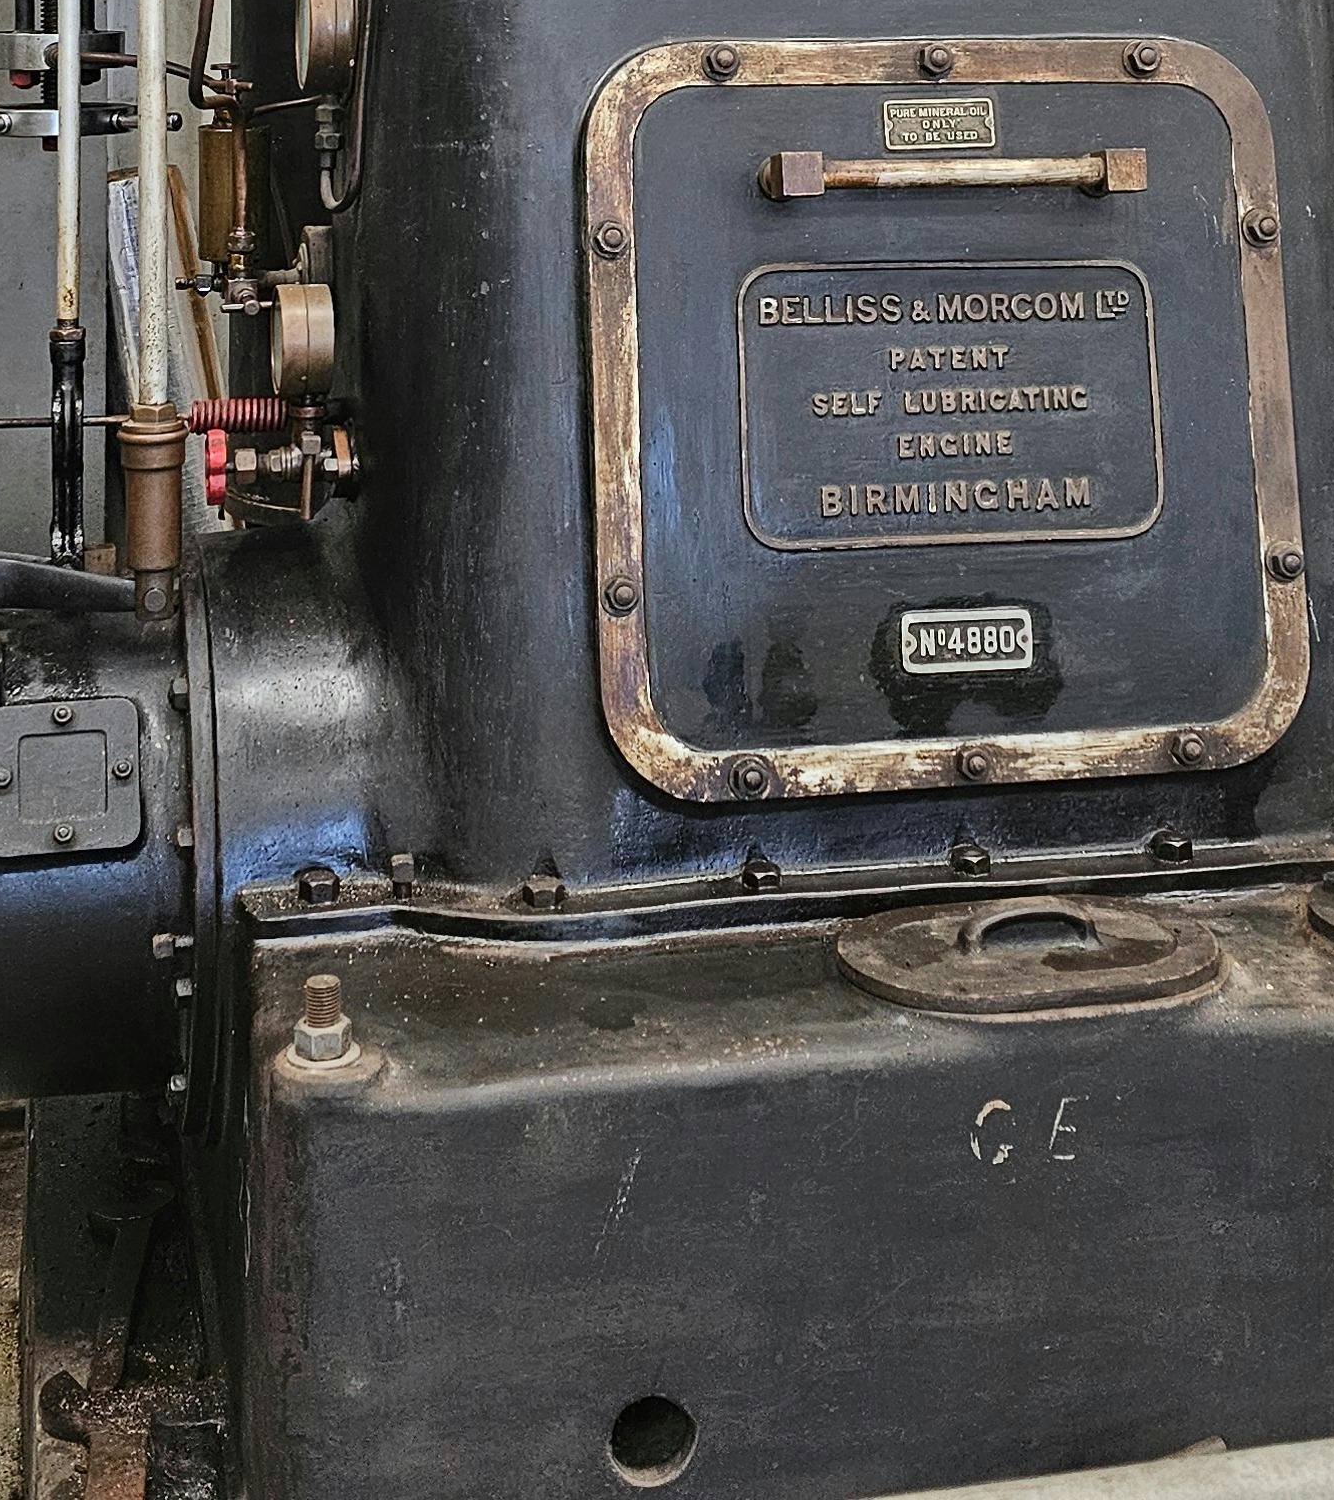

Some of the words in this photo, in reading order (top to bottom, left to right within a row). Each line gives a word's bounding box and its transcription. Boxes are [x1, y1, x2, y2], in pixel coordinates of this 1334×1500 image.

[889, 107, 916, 118] PURE
[918, 107, 967, 117] MINERAL
[969, 106, 987, 116] OIL
[922, 119, 956, 129] ONLY
[901, 132, 918, 142] TO
[925, 131, 940, 141] BE
[947, 130, 978, 140] USED
[759, 294, 902, 325] BELLISS
[912, 300, 930, 323] &
[938, 292, 1085, 321] MORCOM
[890, 346, 1010, 370] PATENT
[812, 391, 882, 416] SELF
[904, 385, 1089, 414] LUBRICATING
[898, 431, 1014, 459] ENGINE
[821, 477, 1092, 518] BIRMINGHAM
